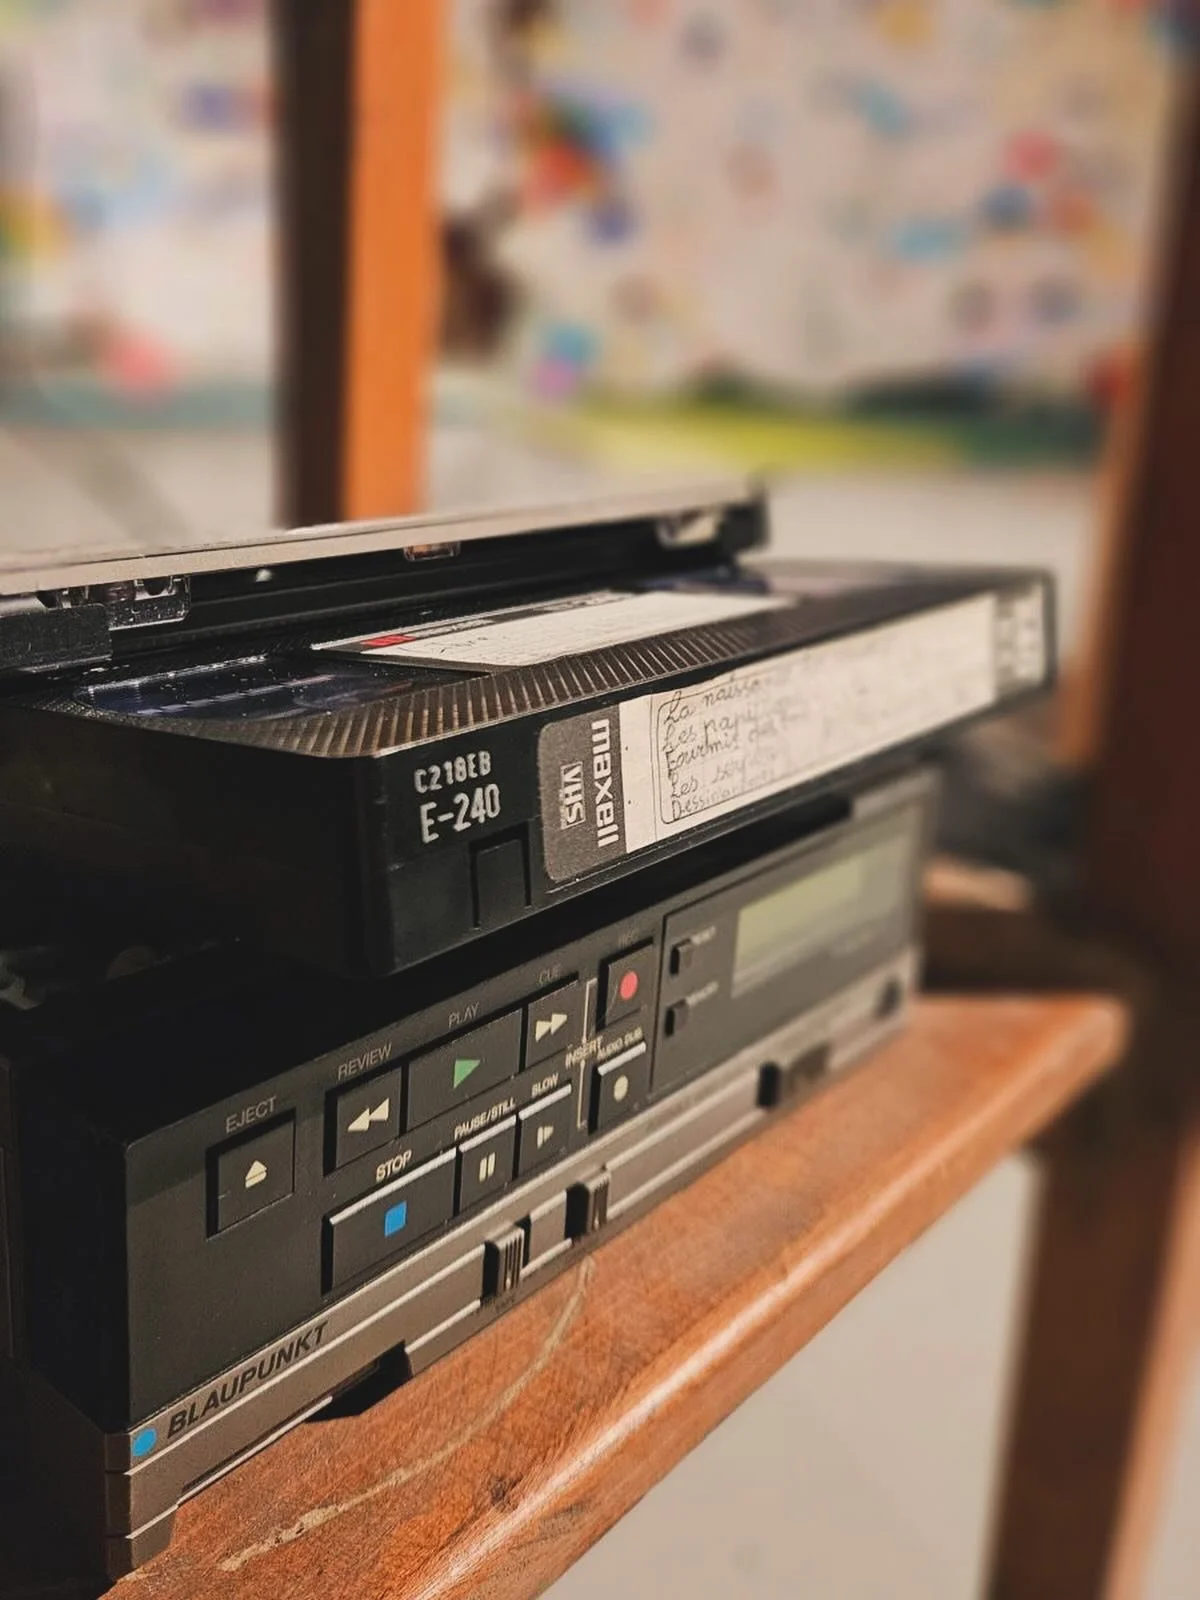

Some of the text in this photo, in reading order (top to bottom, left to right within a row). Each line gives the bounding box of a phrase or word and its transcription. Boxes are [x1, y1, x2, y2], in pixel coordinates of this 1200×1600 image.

[413, 750, 492, 794] C218EB
[591, 718, 619, 848] maxell
[419, 783, 501, 844] E-240
[561, 762, 584, 829] VHS
[449, 1001, 480, 1027] PLAY
[337, 1042, 393, 1081] REVIEW
[565, 1035, 603, 1068] INSERT
[531, 1072, 560, 1099] SLOW
[225, 1095, 277, 1134] EJECT
[454, 1097, 517, 1140] PAUSE/STILL
[375, 1149, 412, 1182] STOP
[167, 1320, 329, 1439] BLAUPUNKT
